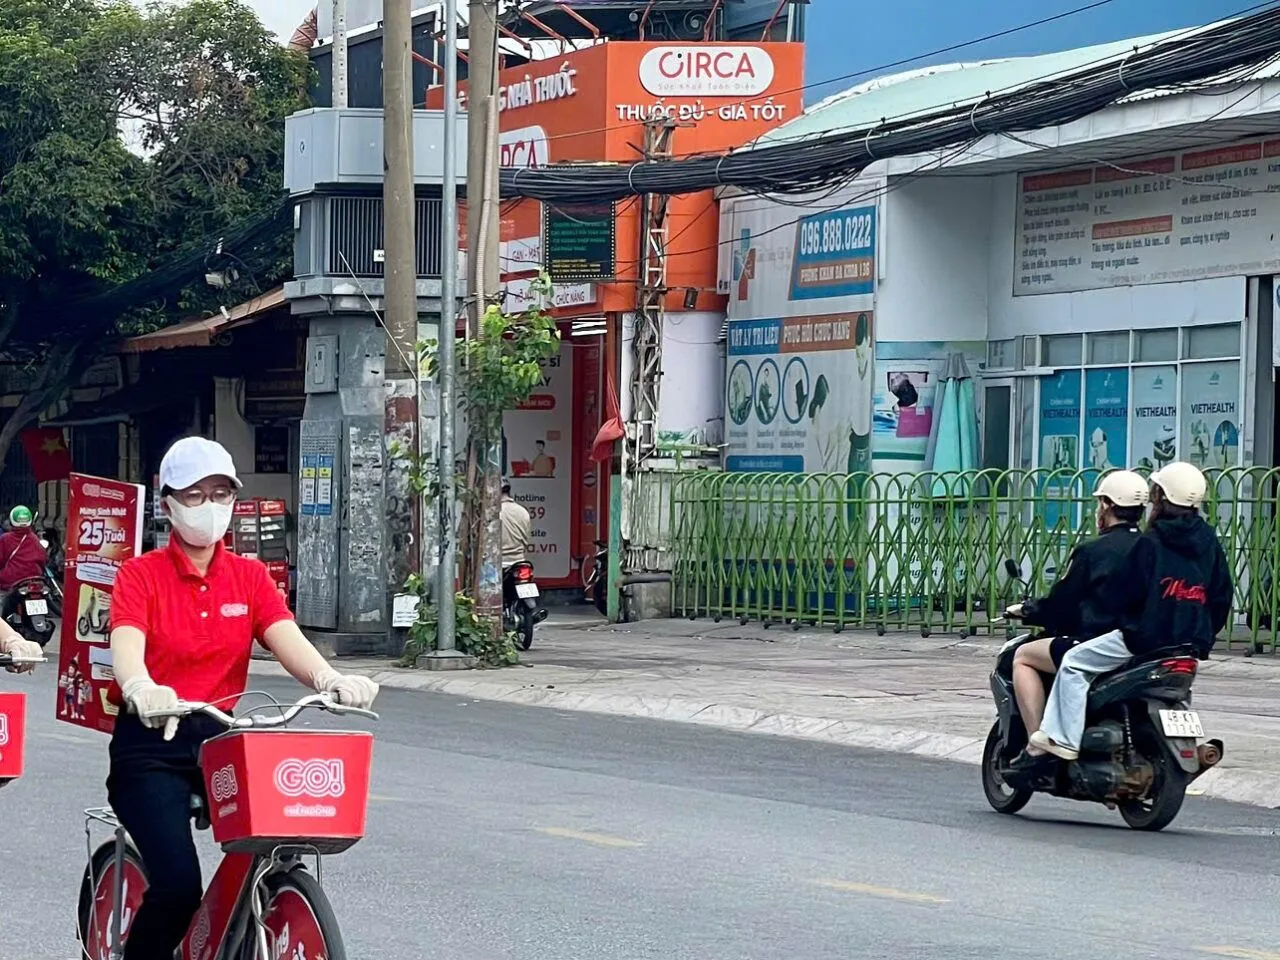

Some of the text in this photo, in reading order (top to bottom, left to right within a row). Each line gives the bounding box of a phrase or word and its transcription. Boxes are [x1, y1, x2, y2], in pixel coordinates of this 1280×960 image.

[658, 51, 756, 79] CIRCA
[507, 74, 533, 109] NHÀ
[534, 61, 578, 103] THUỐC
[616, 97, 677, 121] THUỐC
[679, 99, 705, 121] ĐỦ
[750, 97, 786, 121] TỐT
[501, 138, 538, 168] RCA
[800, 214, 872, 256] 096.888.0222
[1135, 405, 1177, 418] VIETHEALTH
[1191, 402, 1235, 415] VIETHEALTH
[514, 494, 546, 502] hotline
[79, 520, 126, 546] 25 Tuổi
[530, 529, 547, 538] site
[211, 764, 238, 802] GO!
[274, 757, 346, 798] GO!
